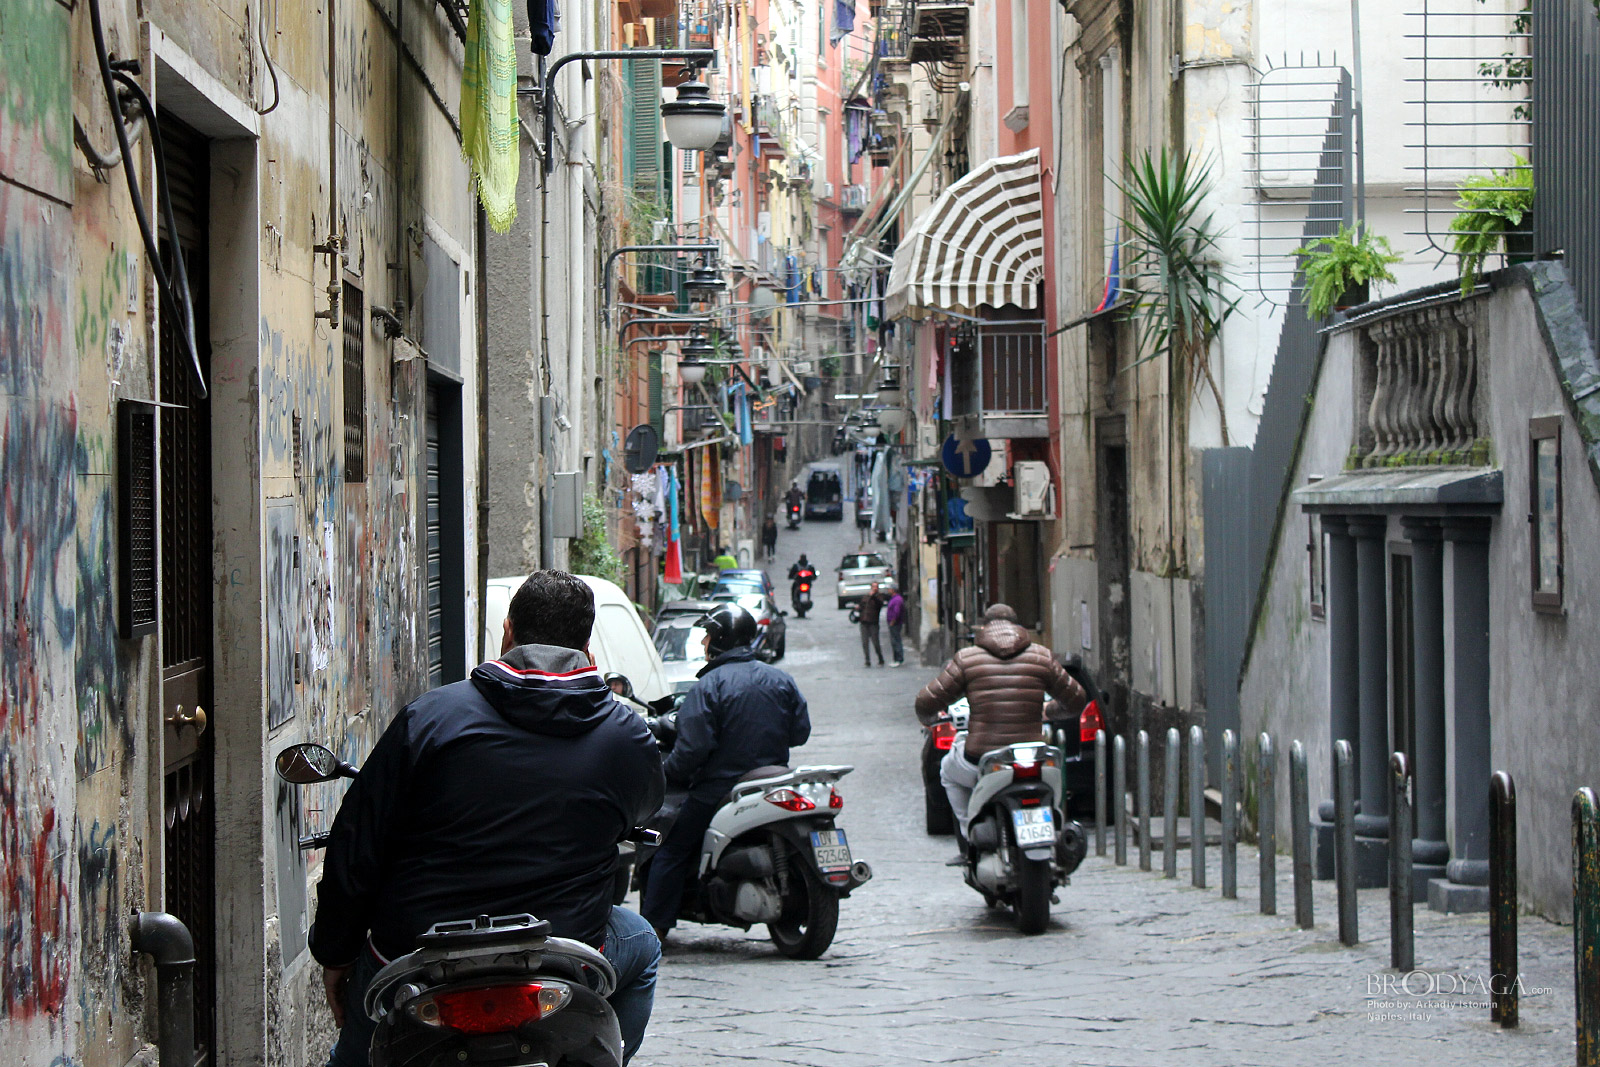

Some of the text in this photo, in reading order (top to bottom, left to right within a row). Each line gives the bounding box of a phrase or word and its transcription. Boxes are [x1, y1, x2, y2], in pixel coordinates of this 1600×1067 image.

[129, 263, 137, 301] 20
[1020, 824, 1053, 840] 41649
[817, 848, 849, 864] 52348
